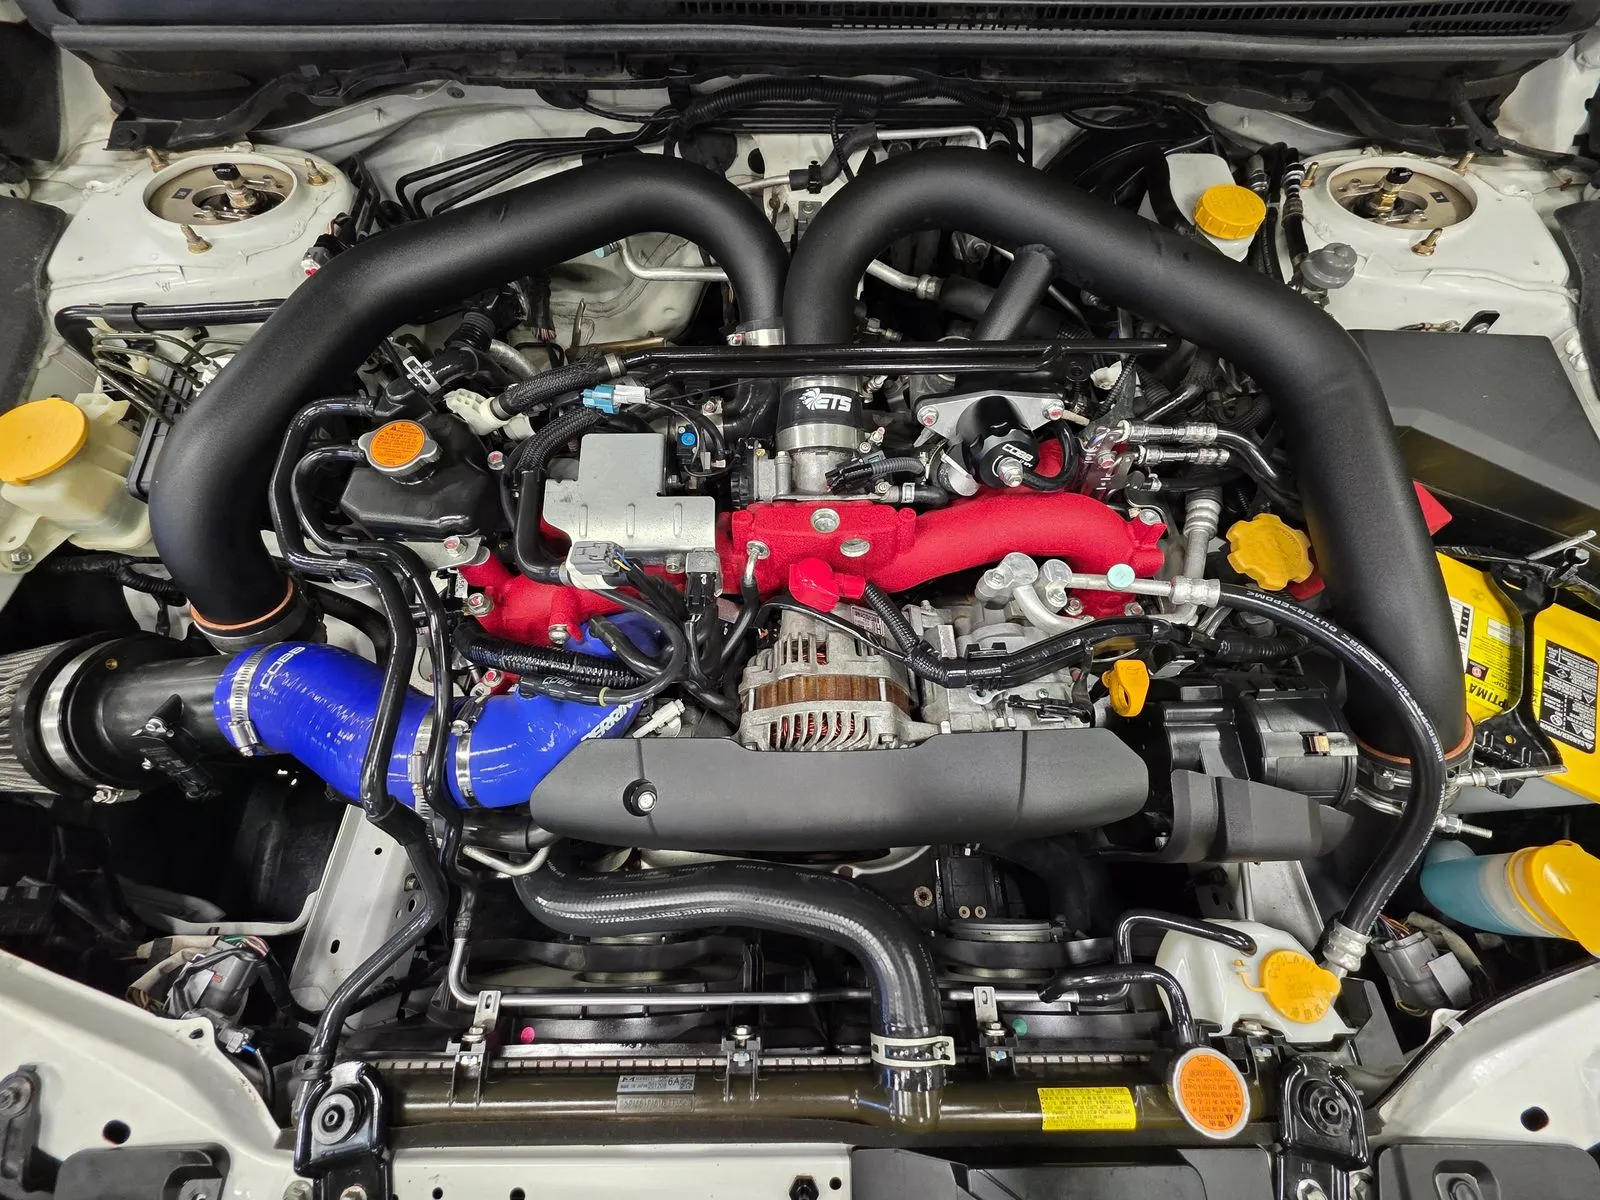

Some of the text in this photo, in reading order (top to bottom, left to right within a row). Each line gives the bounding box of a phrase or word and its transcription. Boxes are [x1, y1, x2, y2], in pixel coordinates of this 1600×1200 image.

[816, 393, 852, 412] ETS
[1002, 443, 1034, 462] COBB
[260, 646, 306, 689] COBB
